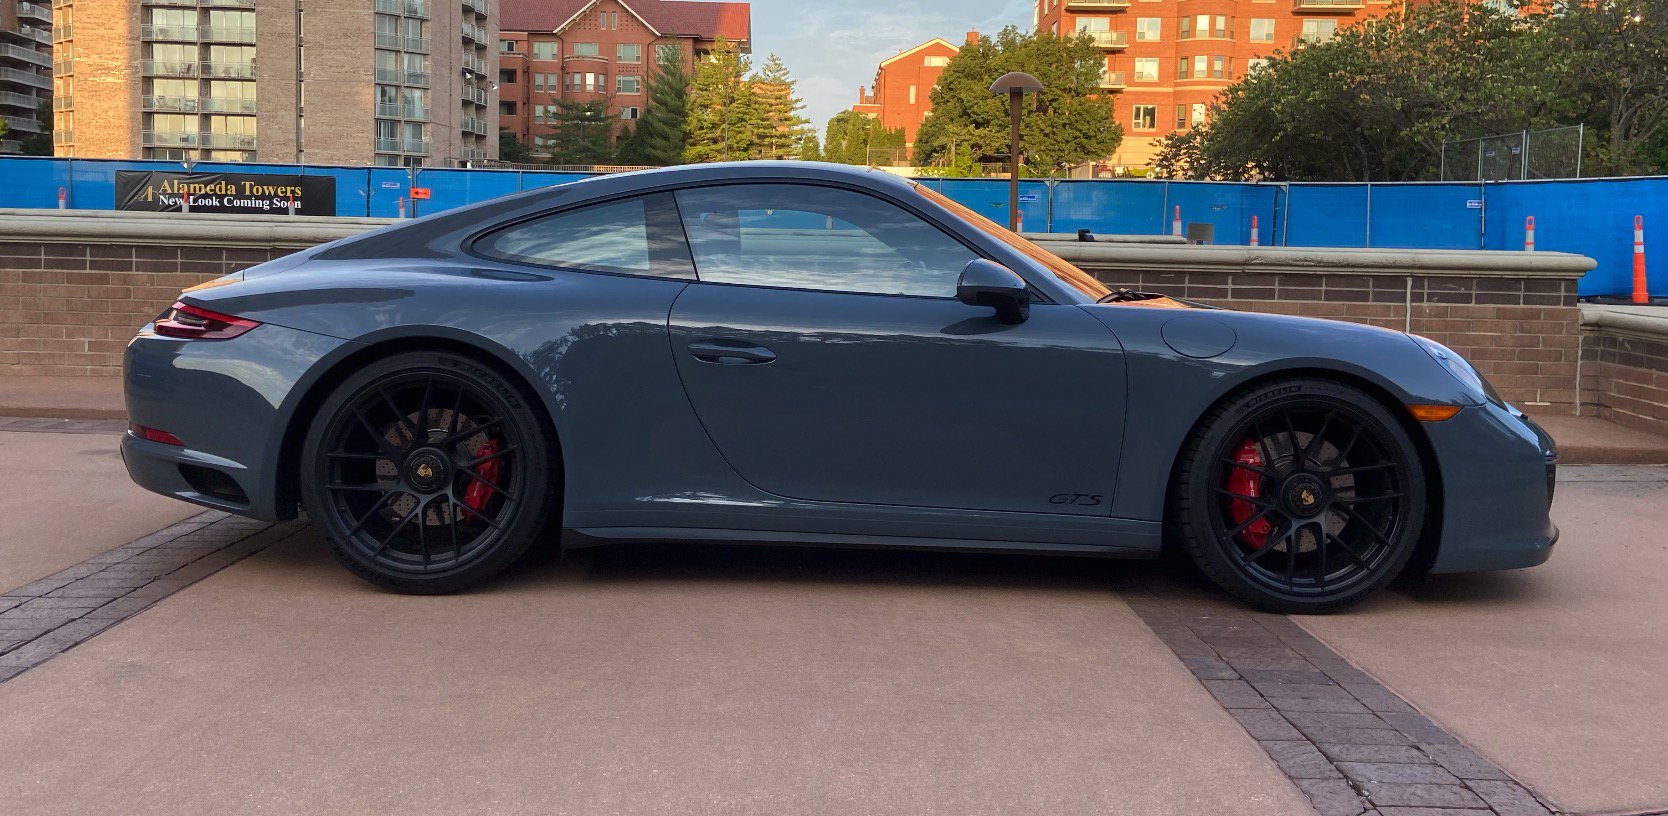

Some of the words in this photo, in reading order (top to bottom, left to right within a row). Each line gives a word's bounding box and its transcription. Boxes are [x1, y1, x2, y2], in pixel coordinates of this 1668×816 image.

[159, 179, 237, 195] Alameda
[241, 181, 302, 197] Towers
[159, 195, 186, 205] New
[189, 196, 220, 206] Look
[224, 196, 270, 210] Coming
[1048, 493, 1104, 506] GTS
